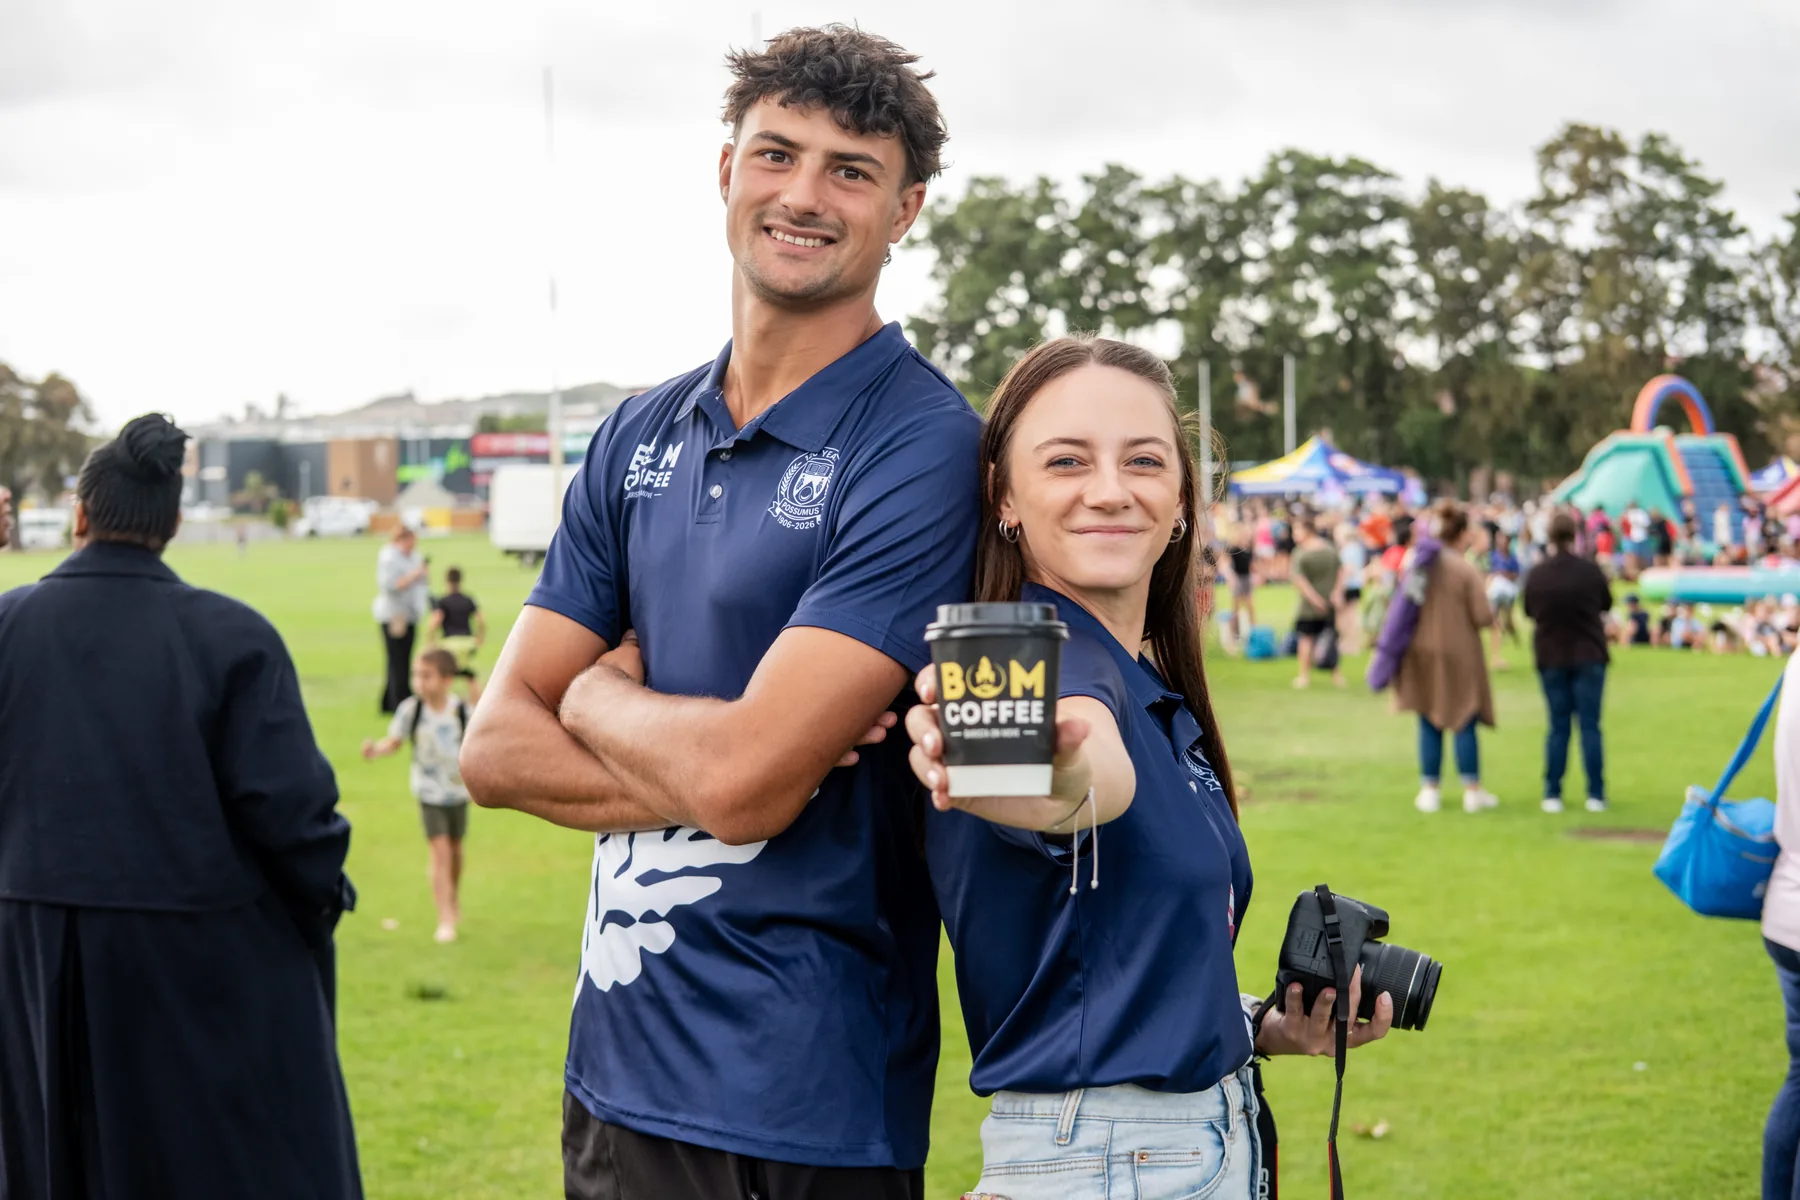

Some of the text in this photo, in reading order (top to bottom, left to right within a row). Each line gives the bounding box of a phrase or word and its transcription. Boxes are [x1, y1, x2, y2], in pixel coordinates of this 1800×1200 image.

[781, 501, 820, 516] POSSUMUS
[777, 514, 815, 530] 1906-2026
[944, 700, 1045, 726] COFFEE
